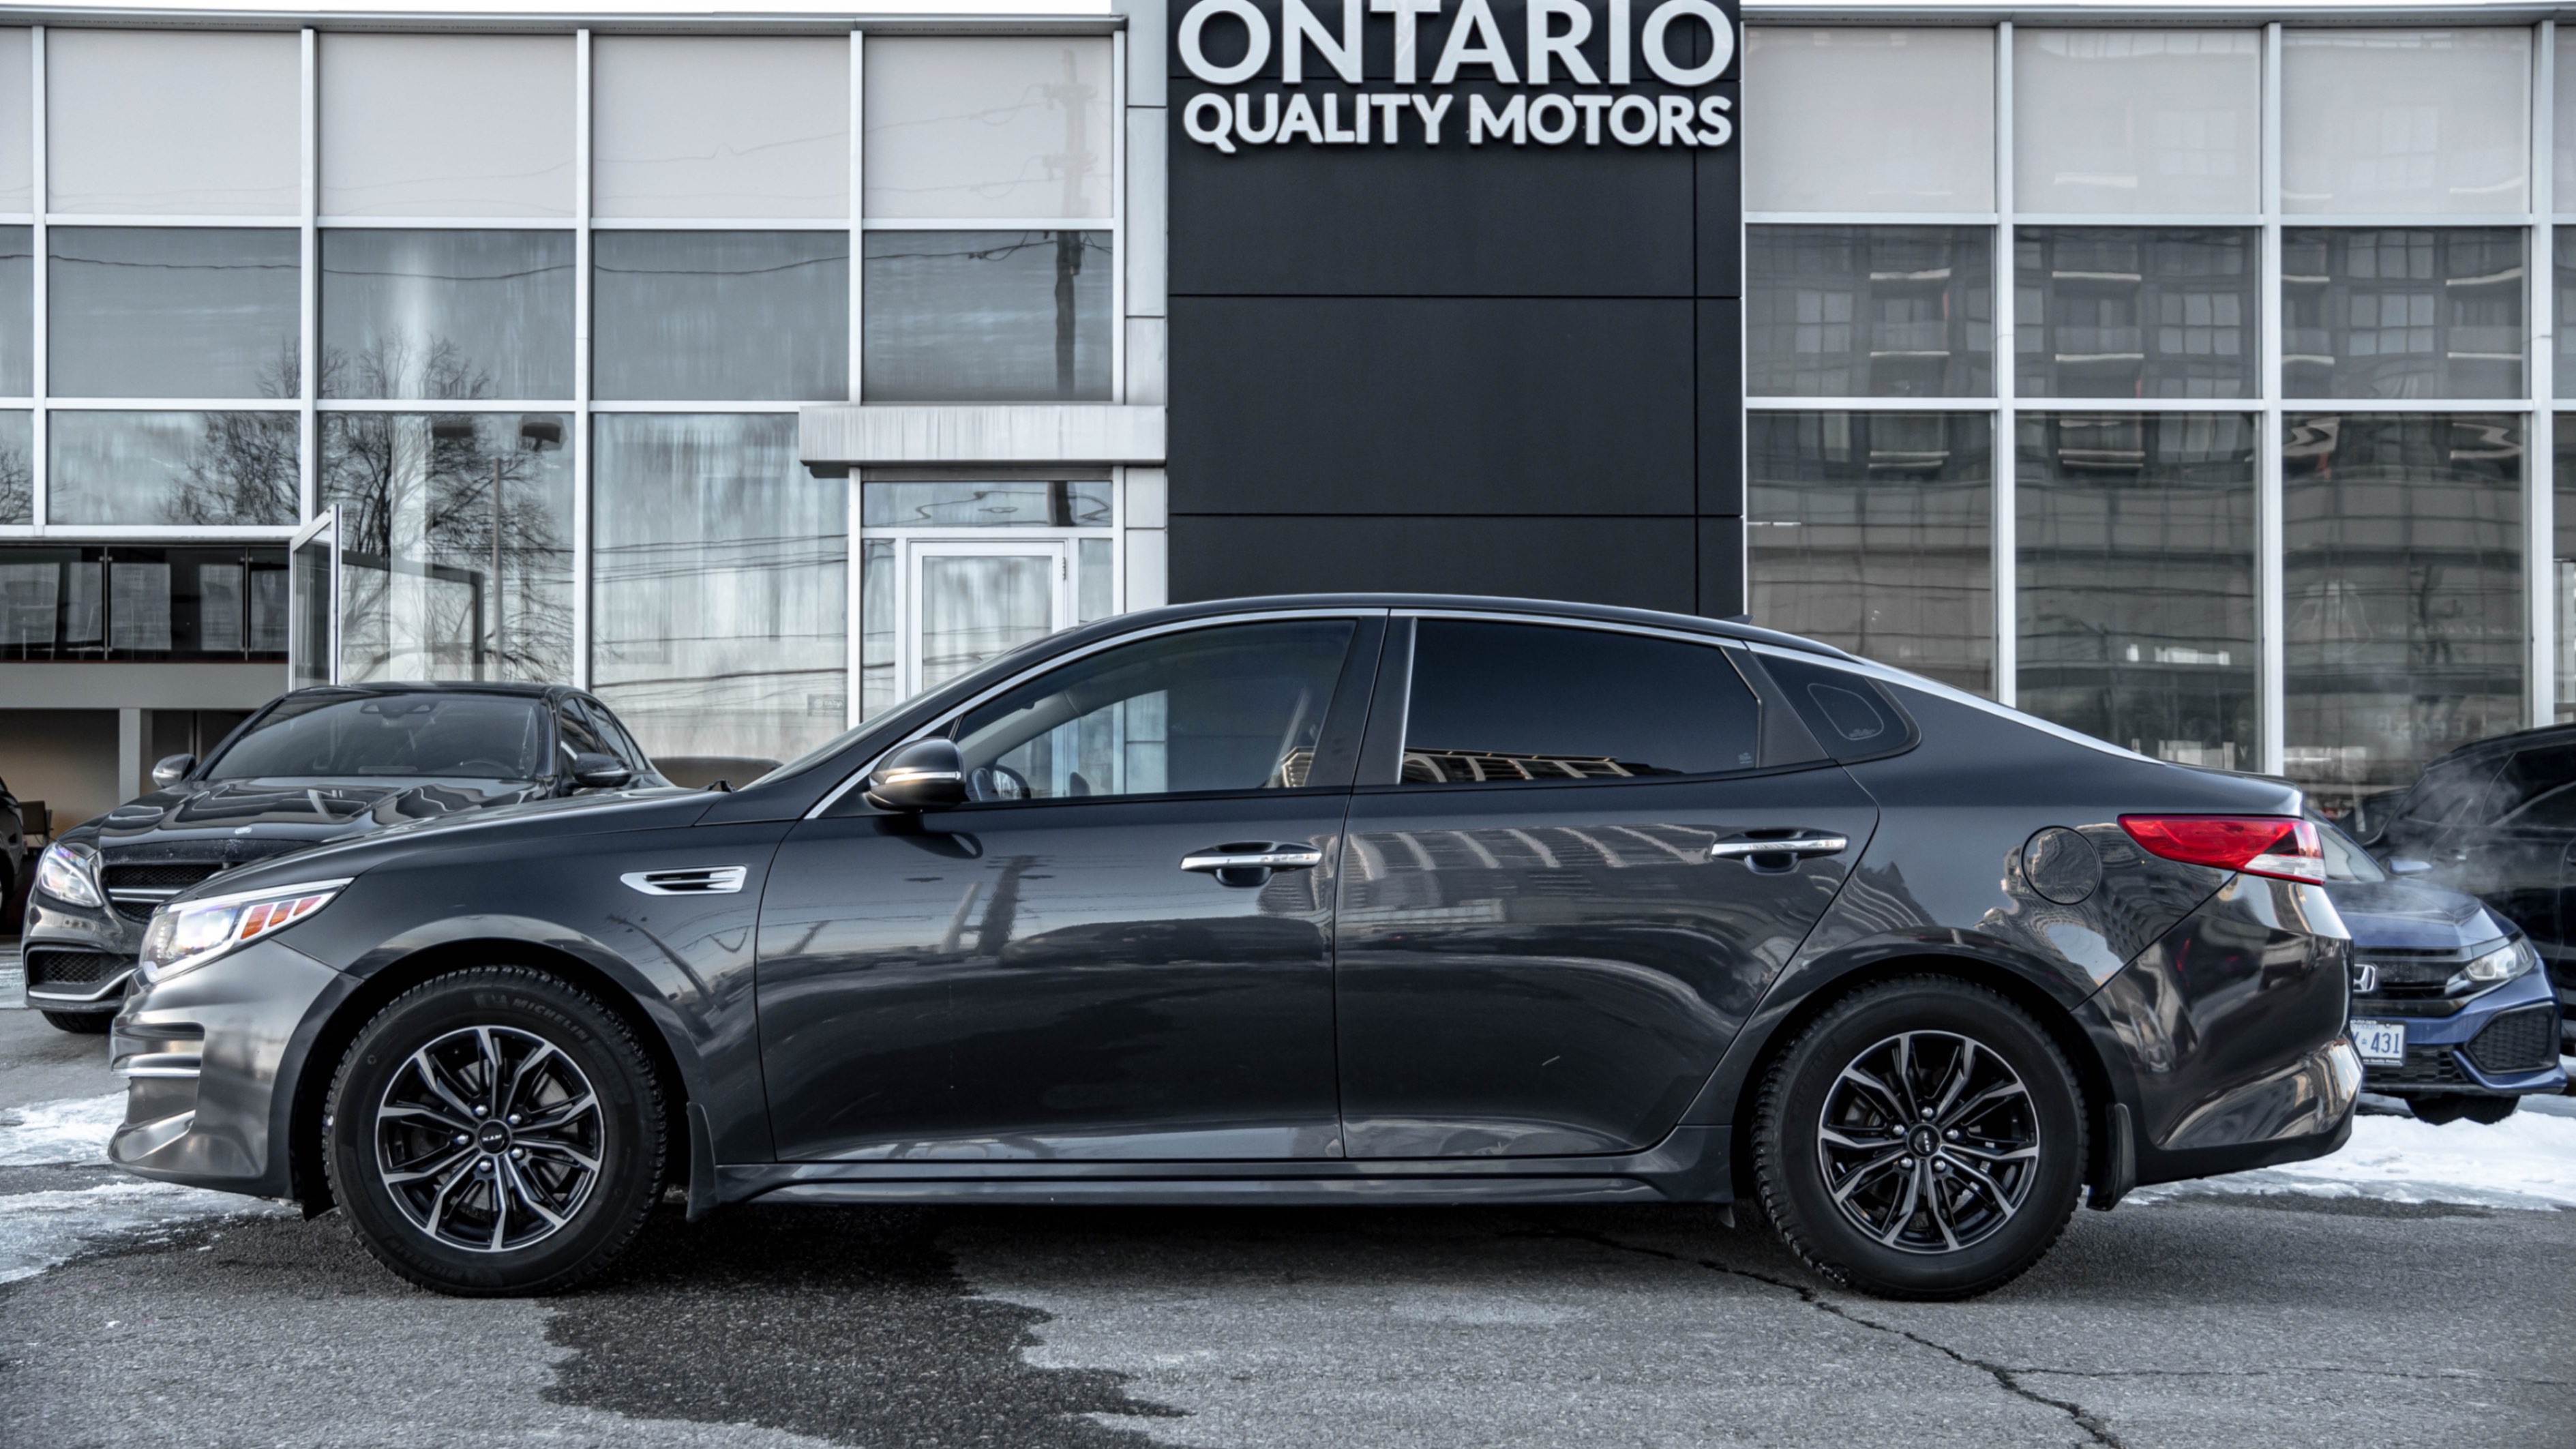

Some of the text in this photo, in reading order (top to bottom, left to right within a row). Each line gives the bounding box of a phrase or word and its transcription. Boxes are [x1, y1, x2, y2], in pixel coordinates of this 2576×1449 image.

[1178, 0, 1734, 87] ONTARIO
[1184, 93, 1733, 153] QUALITY MOTORS
[513, 998, 588, 1041] MICHELIN
[2371, 1032, 2399, 1054] 431
